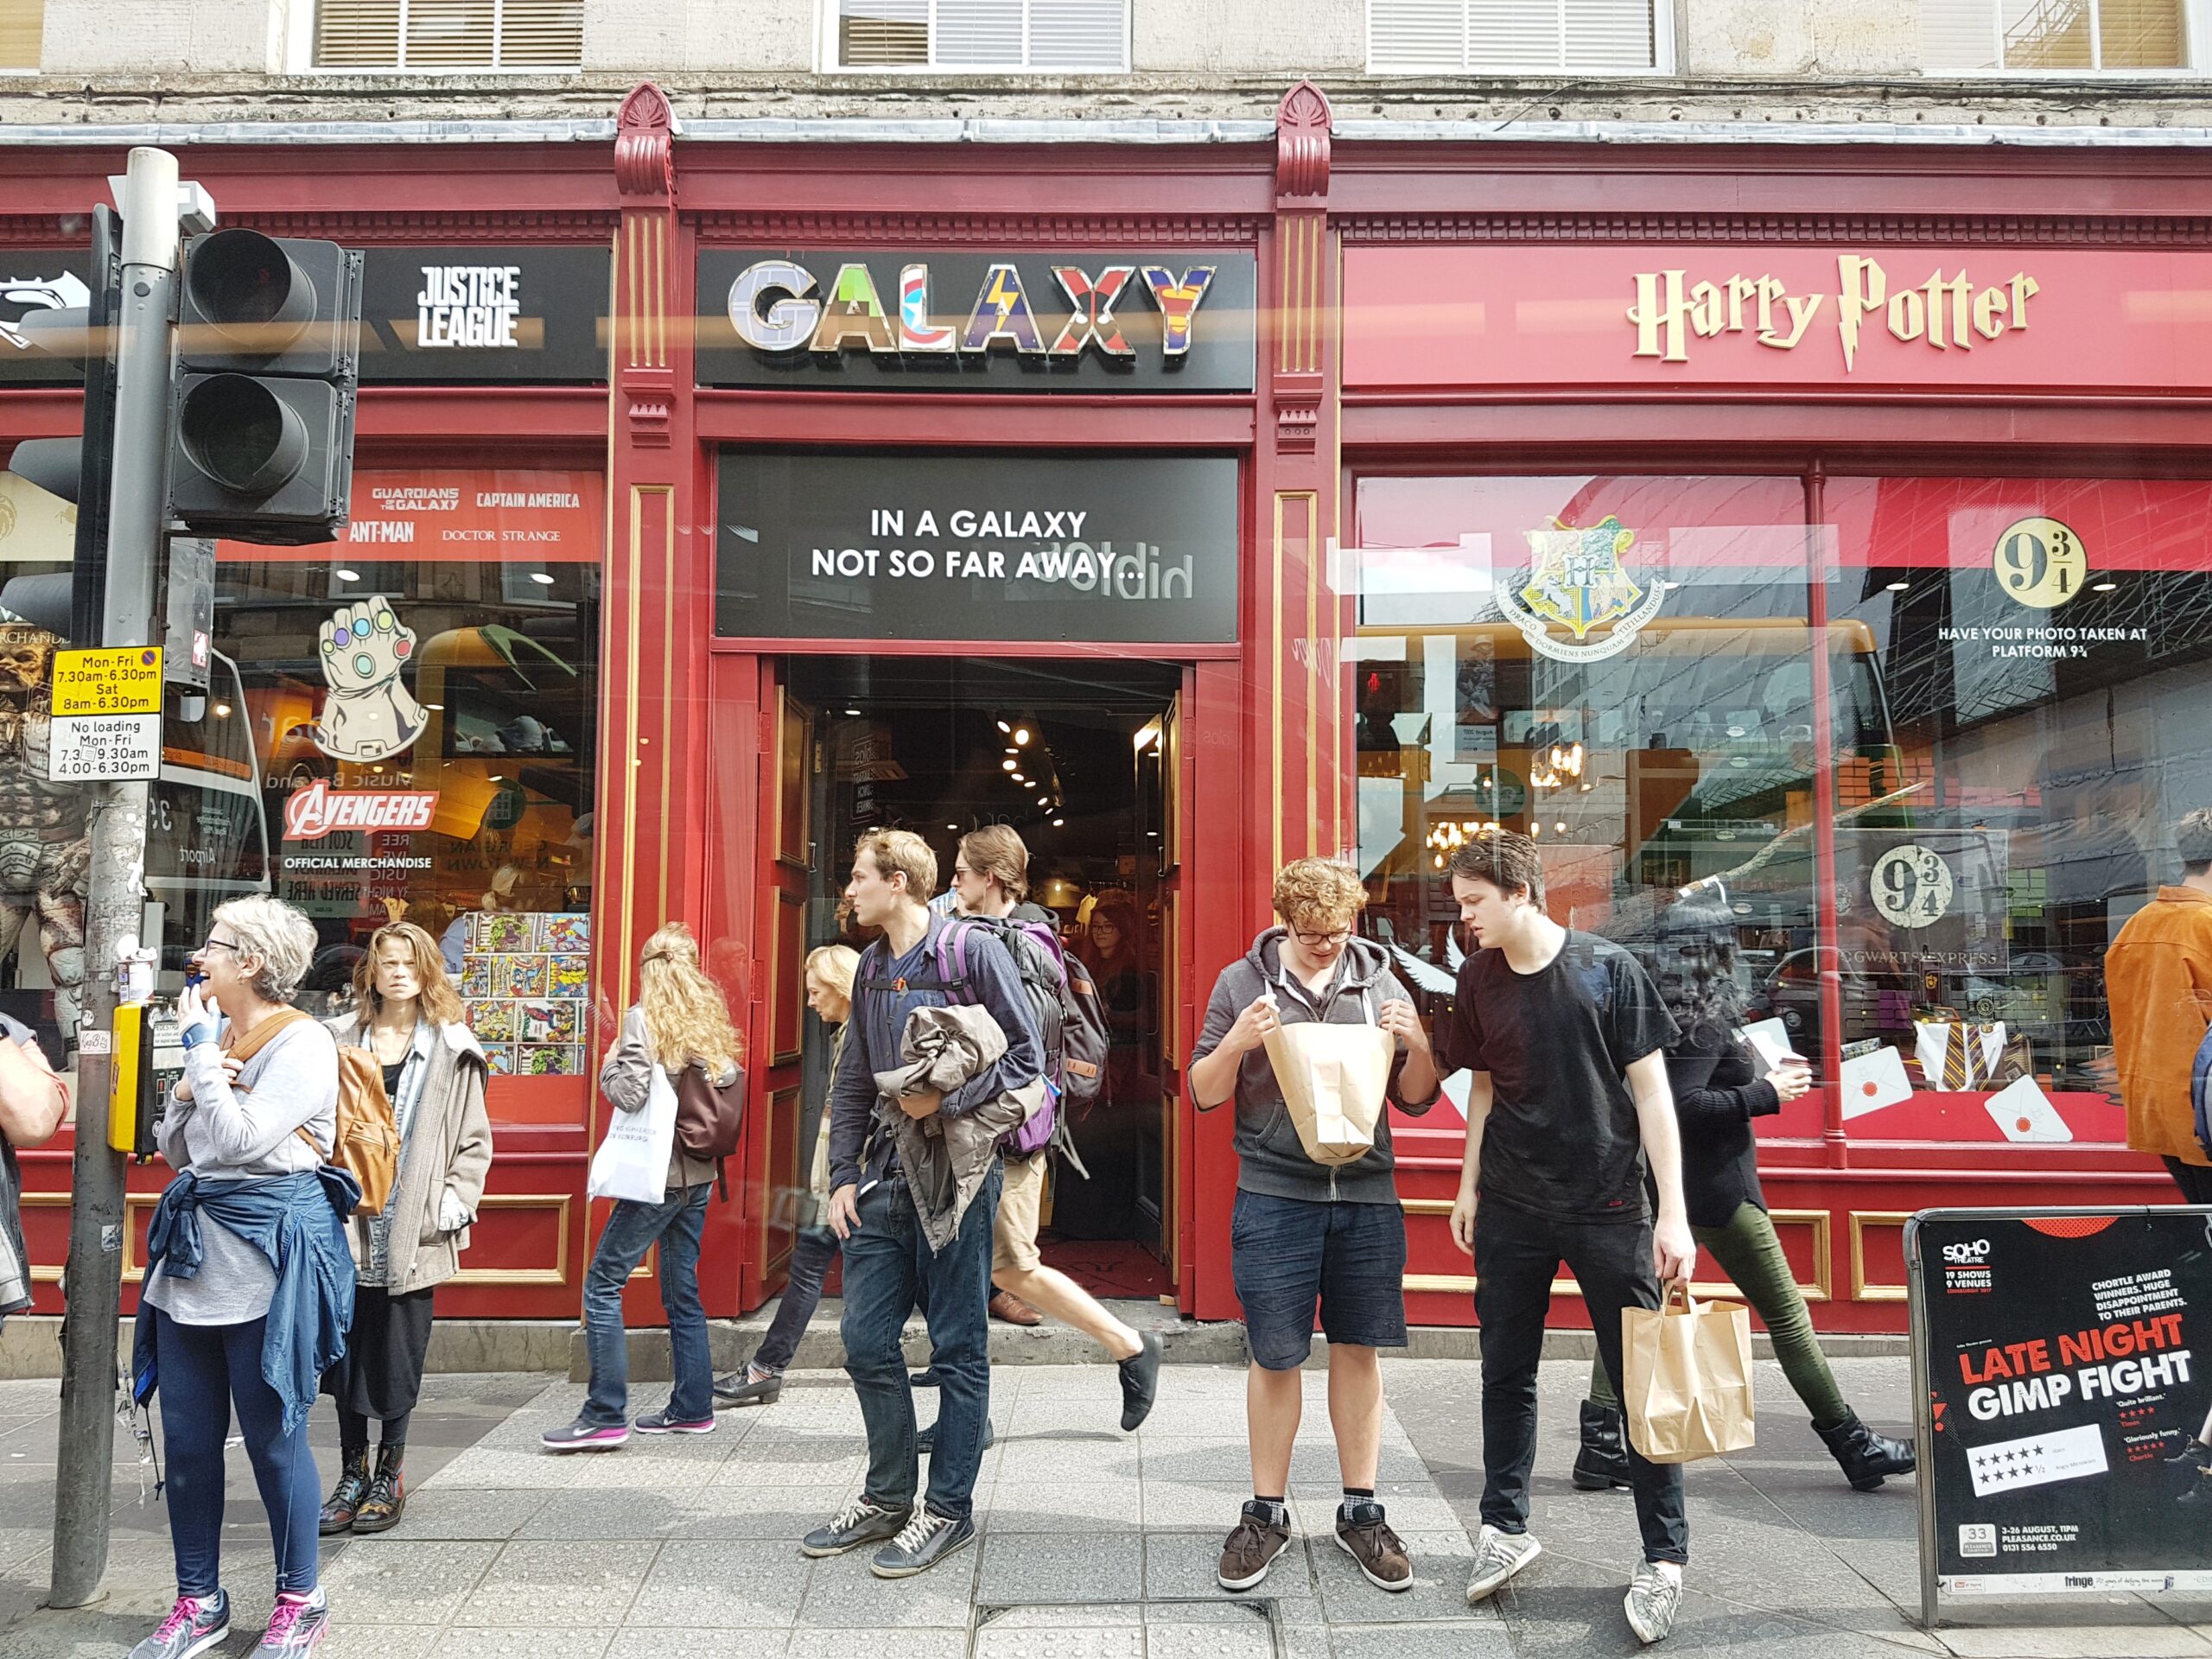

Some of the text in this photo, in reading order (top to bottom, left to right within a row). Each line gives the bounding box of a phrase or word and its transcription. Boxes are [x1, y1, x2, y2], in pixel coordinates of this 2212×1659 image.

[418, 266, 520, 308] JUSTICE
[728, 260, 1217, 355] GALAXY
[1626, 255, 2040, 372] Harry Potter
[419, 306, 518, 347] LEAGUE
[372, 488, 459, 499] GUARDIANS
[477, 493, 580, 508] CAPTAIN AMERICA
[395, 499, 458, 510] GALAXY
[349, 521, 415, 543] ANT-MAN
[871, 509, 1087, 537] IN A GALAXY
[442, 531, 560, 542] DOCTOR STRANGE
[811, 550, 879, 578] NOT
[888, 550, 935, 578] SO
[946, 550, 1005, 578] FAR
[1509, 589, 1661, 658] DRACO DORMIENS NUNQUAM TITILLANDUS
[1938, 626, 2147, 641] HAVE YOUR PHOTO TAKEN AT
[1992, 645, 2067, 658] PLATFORM
[96, 684, 118, 695] Sat
[71, 721, 141, 734] No loading
[58, 763, 149, 776] 4.00-6.30pm
[289, 784, 435, 835] AVENGERS
[284, 857, 340, 869] OFFICIAL
[342, 857, 432, 869] MERCHANDISE
[1942, 1239, 1990, 1261] SOHO
[2092, 1269, 2171, 1291] CHORTLE AWARD
[2094, 1280, 2171, 1301] WINNERS. HUGE
[2096, 1288, 2179, 1311] DISAPPOINTMENT
[2098, 1298, 2188, 1321] TO THEIR PARENTS.
[1958, 1313, 2183, 1385] LATE NIGHT
[1967, 1350, 2191, 1421] GIMP FIGHT
[1968, 1528, 1986, 1540] 33
[2002, 1534, 2076, 1543] PLEASANCE.CO.UK
[2022, 1525, 2058, 1535] AUGUST,
[2065, 1575, 2094, 1588] fringe
